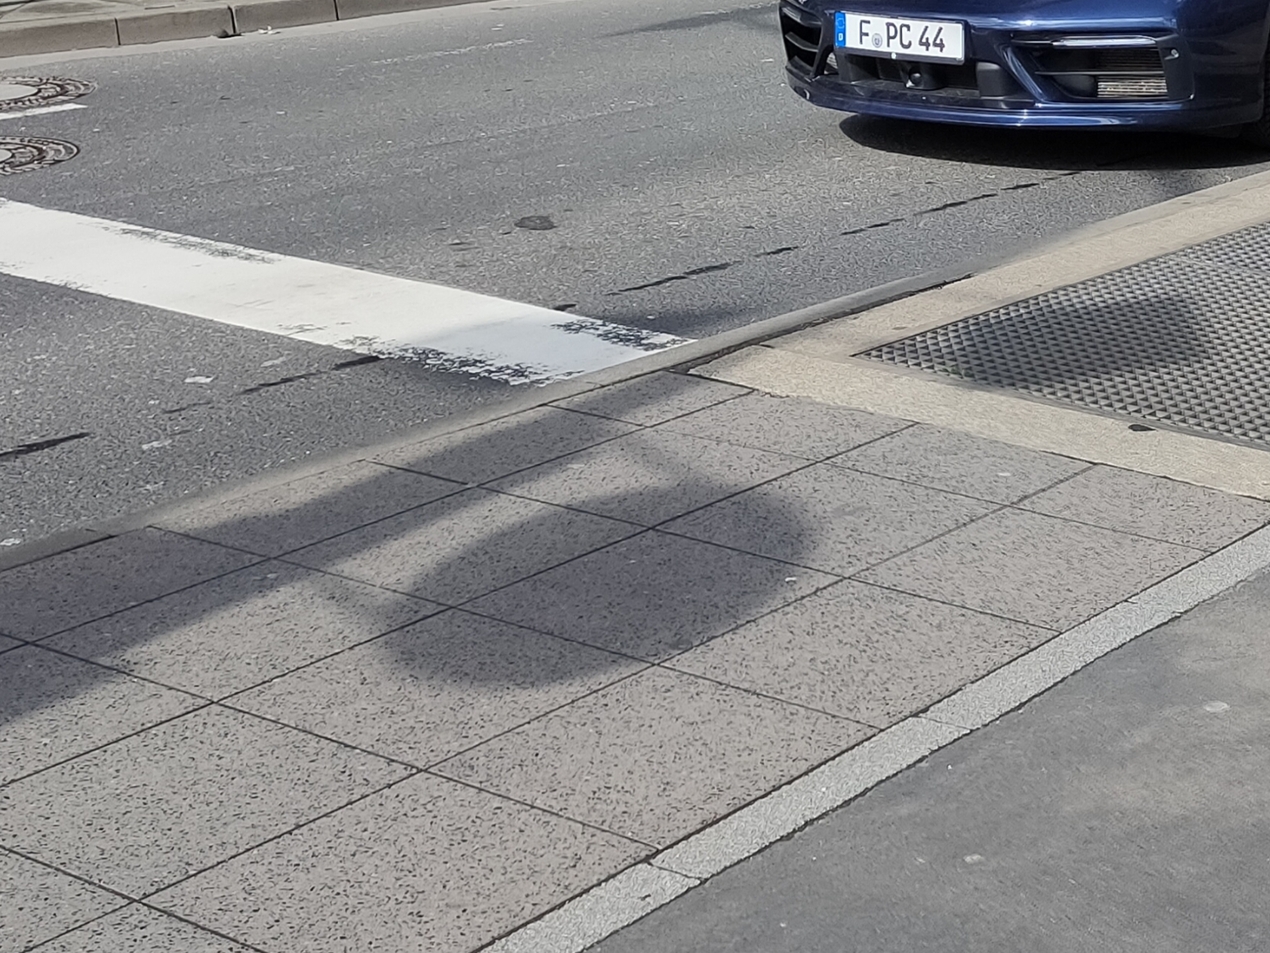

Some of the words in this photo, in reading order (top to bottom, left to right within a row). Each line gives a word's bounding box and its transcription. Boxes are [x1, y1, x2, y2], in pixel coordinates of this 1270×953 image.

[859, 19, 871, 45] F
[885, 22, 912, 49] PC
[918, 25, 946, 53] 44
